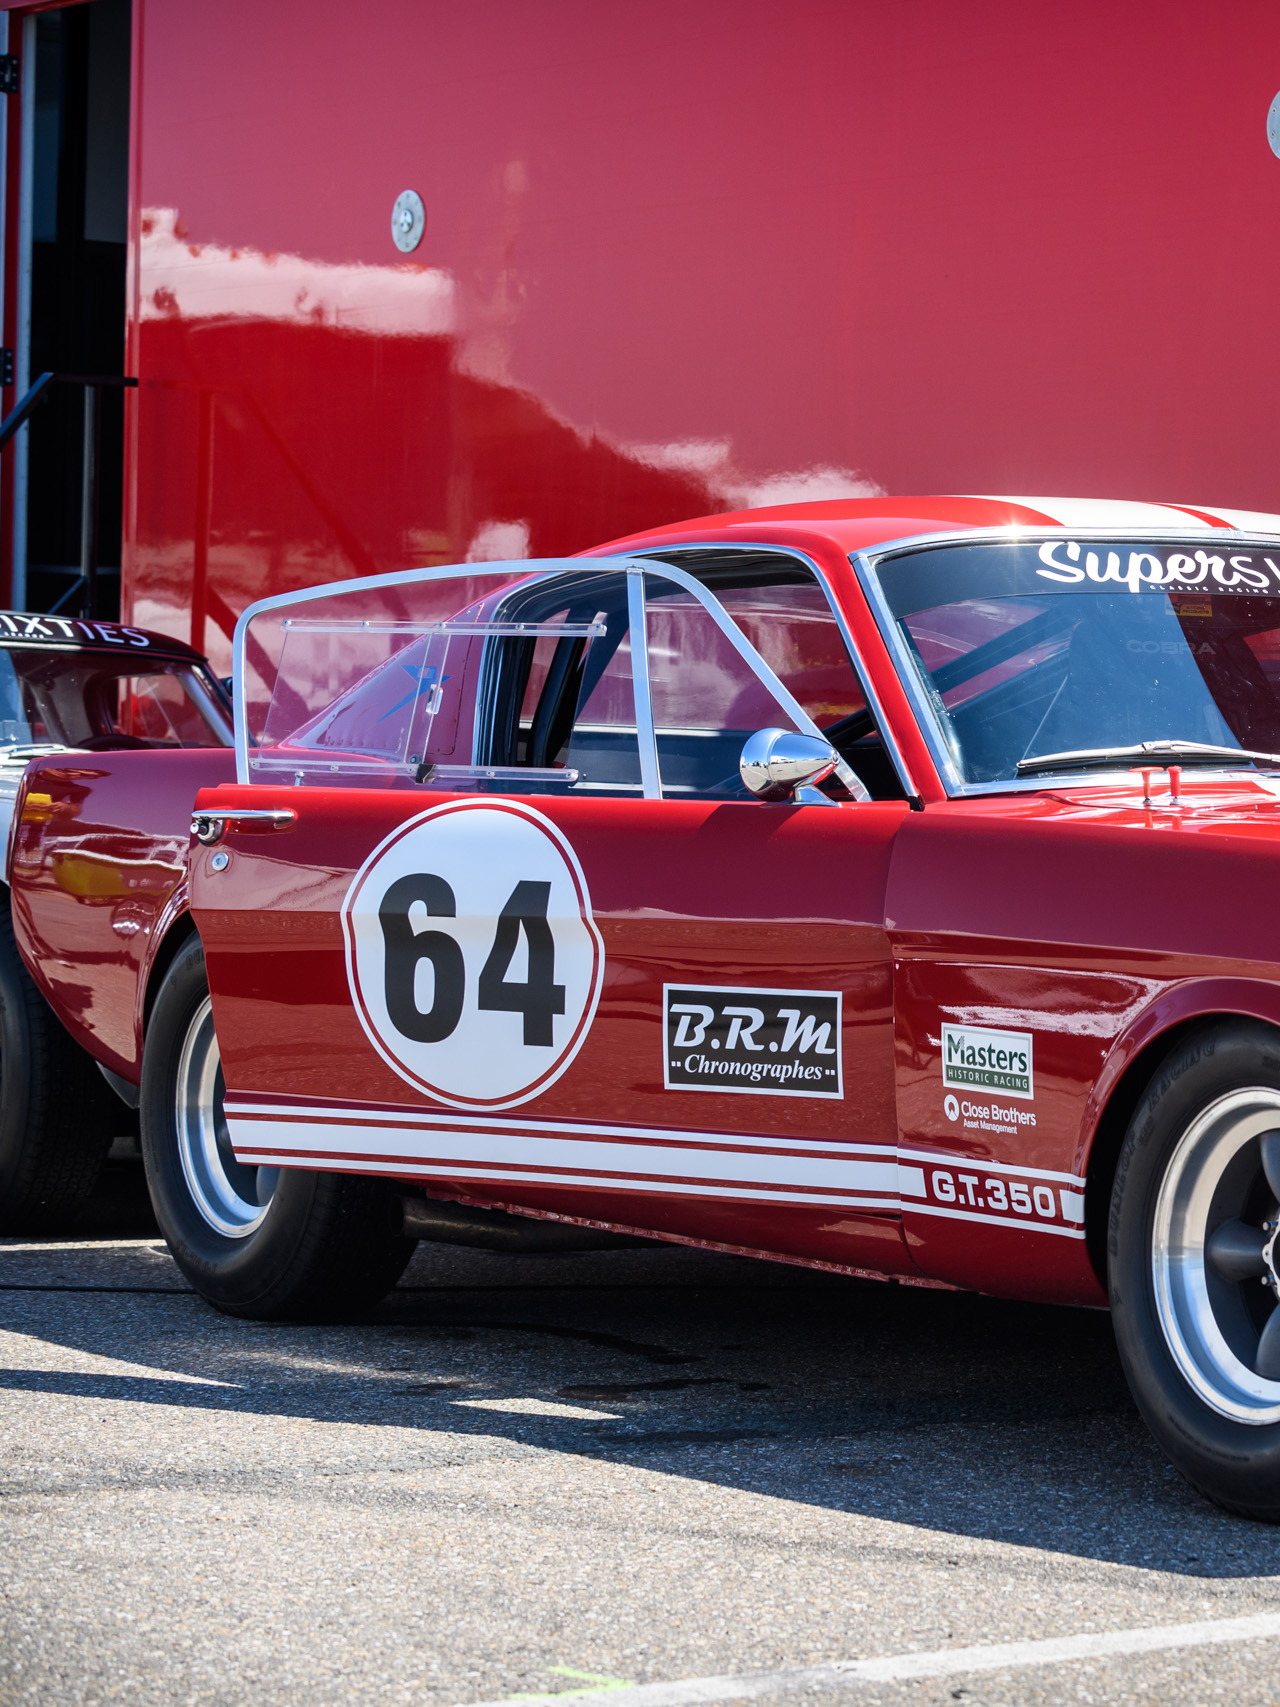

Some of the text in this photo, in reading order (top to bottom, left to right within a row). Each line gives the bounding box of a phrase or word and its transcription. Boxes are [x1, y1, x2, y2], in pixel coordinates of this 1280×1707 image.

[0, 615, 150, 647] IXTIES
[1126, 640, 1217, 655] COBRA
[378, 873, 566, 1047] 64
[670, 1003, 836, 1055] B.R.M
[684, 1054, 823, 1083] Chronographes
[947, 1034, 1028, 1073] Masters
[948, 1069, 1028, 1089] HISTORIC RACING
[961, 1101, 1037, 1126] Close Brothers
[963, 1119, 1018, 1135] Asset Management
[932, 1170, 1056, 1218] G.T.350
